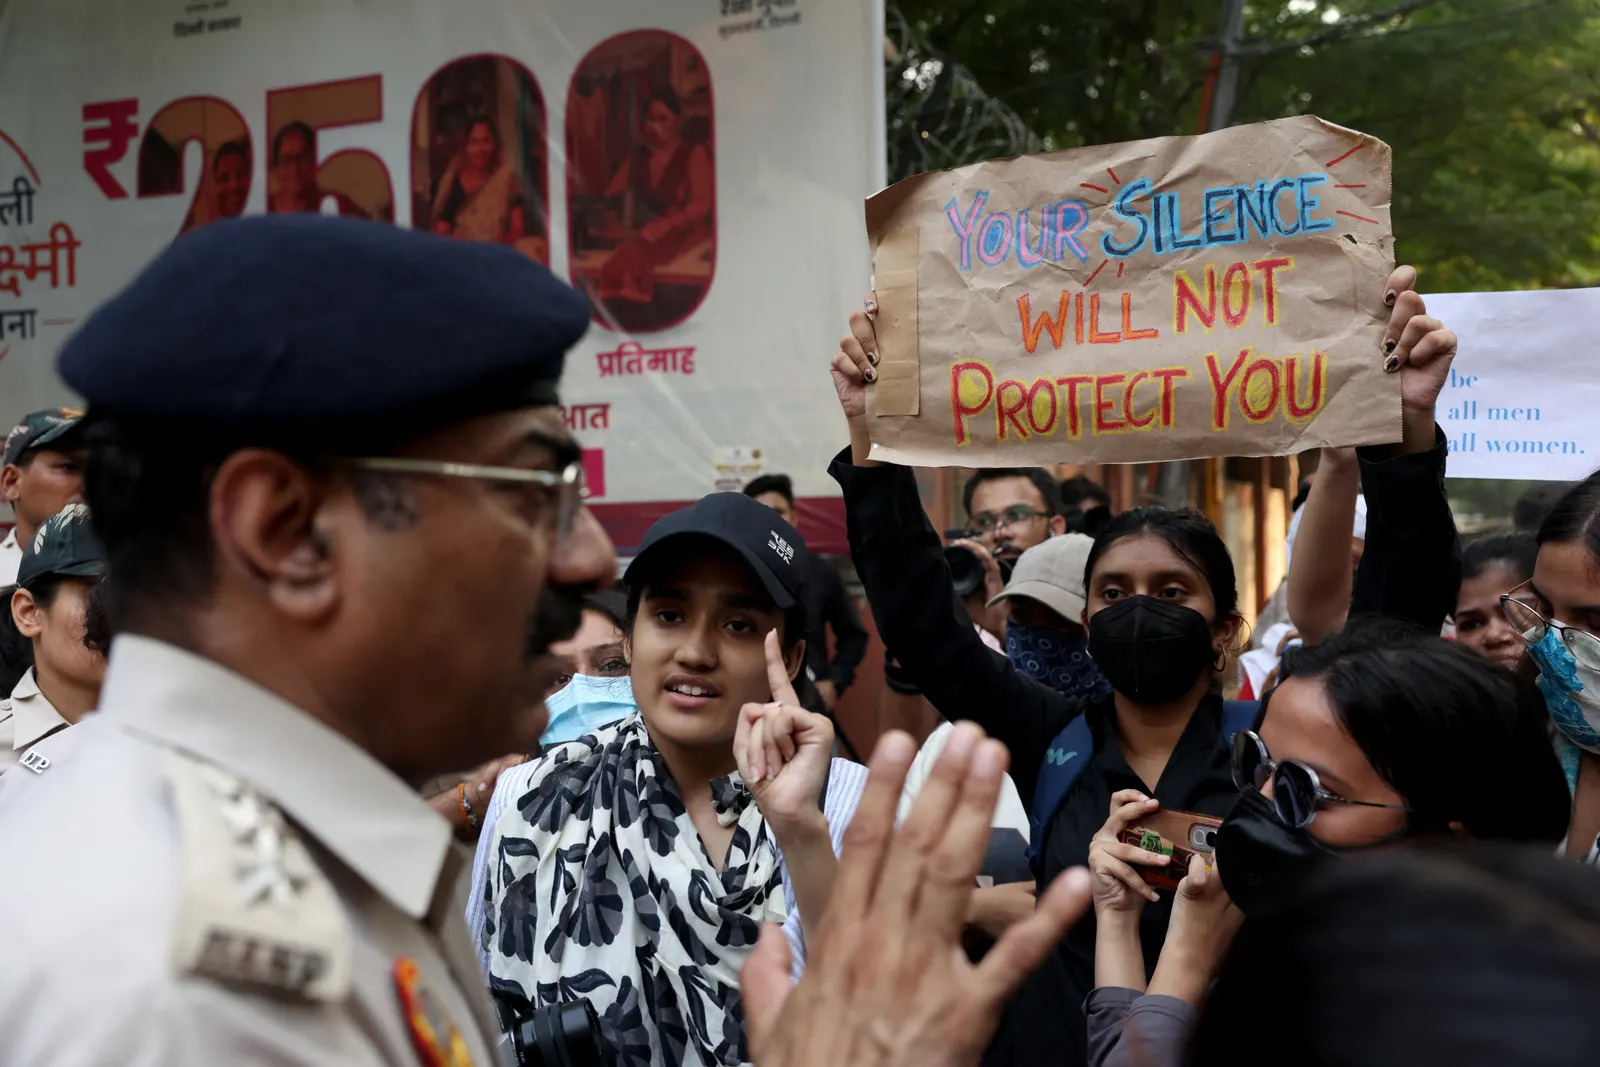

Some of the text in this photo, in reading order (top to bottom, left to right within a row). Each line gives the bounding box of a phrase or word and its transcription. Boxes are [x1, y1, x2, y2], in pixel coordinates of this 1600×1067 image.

[945, 173, 1336, 270] YOUR SILENCE
[1016, 256, 1294, 353] WILL NOT
[0, 308, 37, 340] ना
[596, 341, 696, 377] प्रतिमाह
[1451, 368, 1478, 388] be
[949, 346, 1328, 447] PROTECT YOU
[1448, 400, 1477, 420] all
[1487, 406, 1541, 421] men
[1447, 432, 1585, 455] all women.
